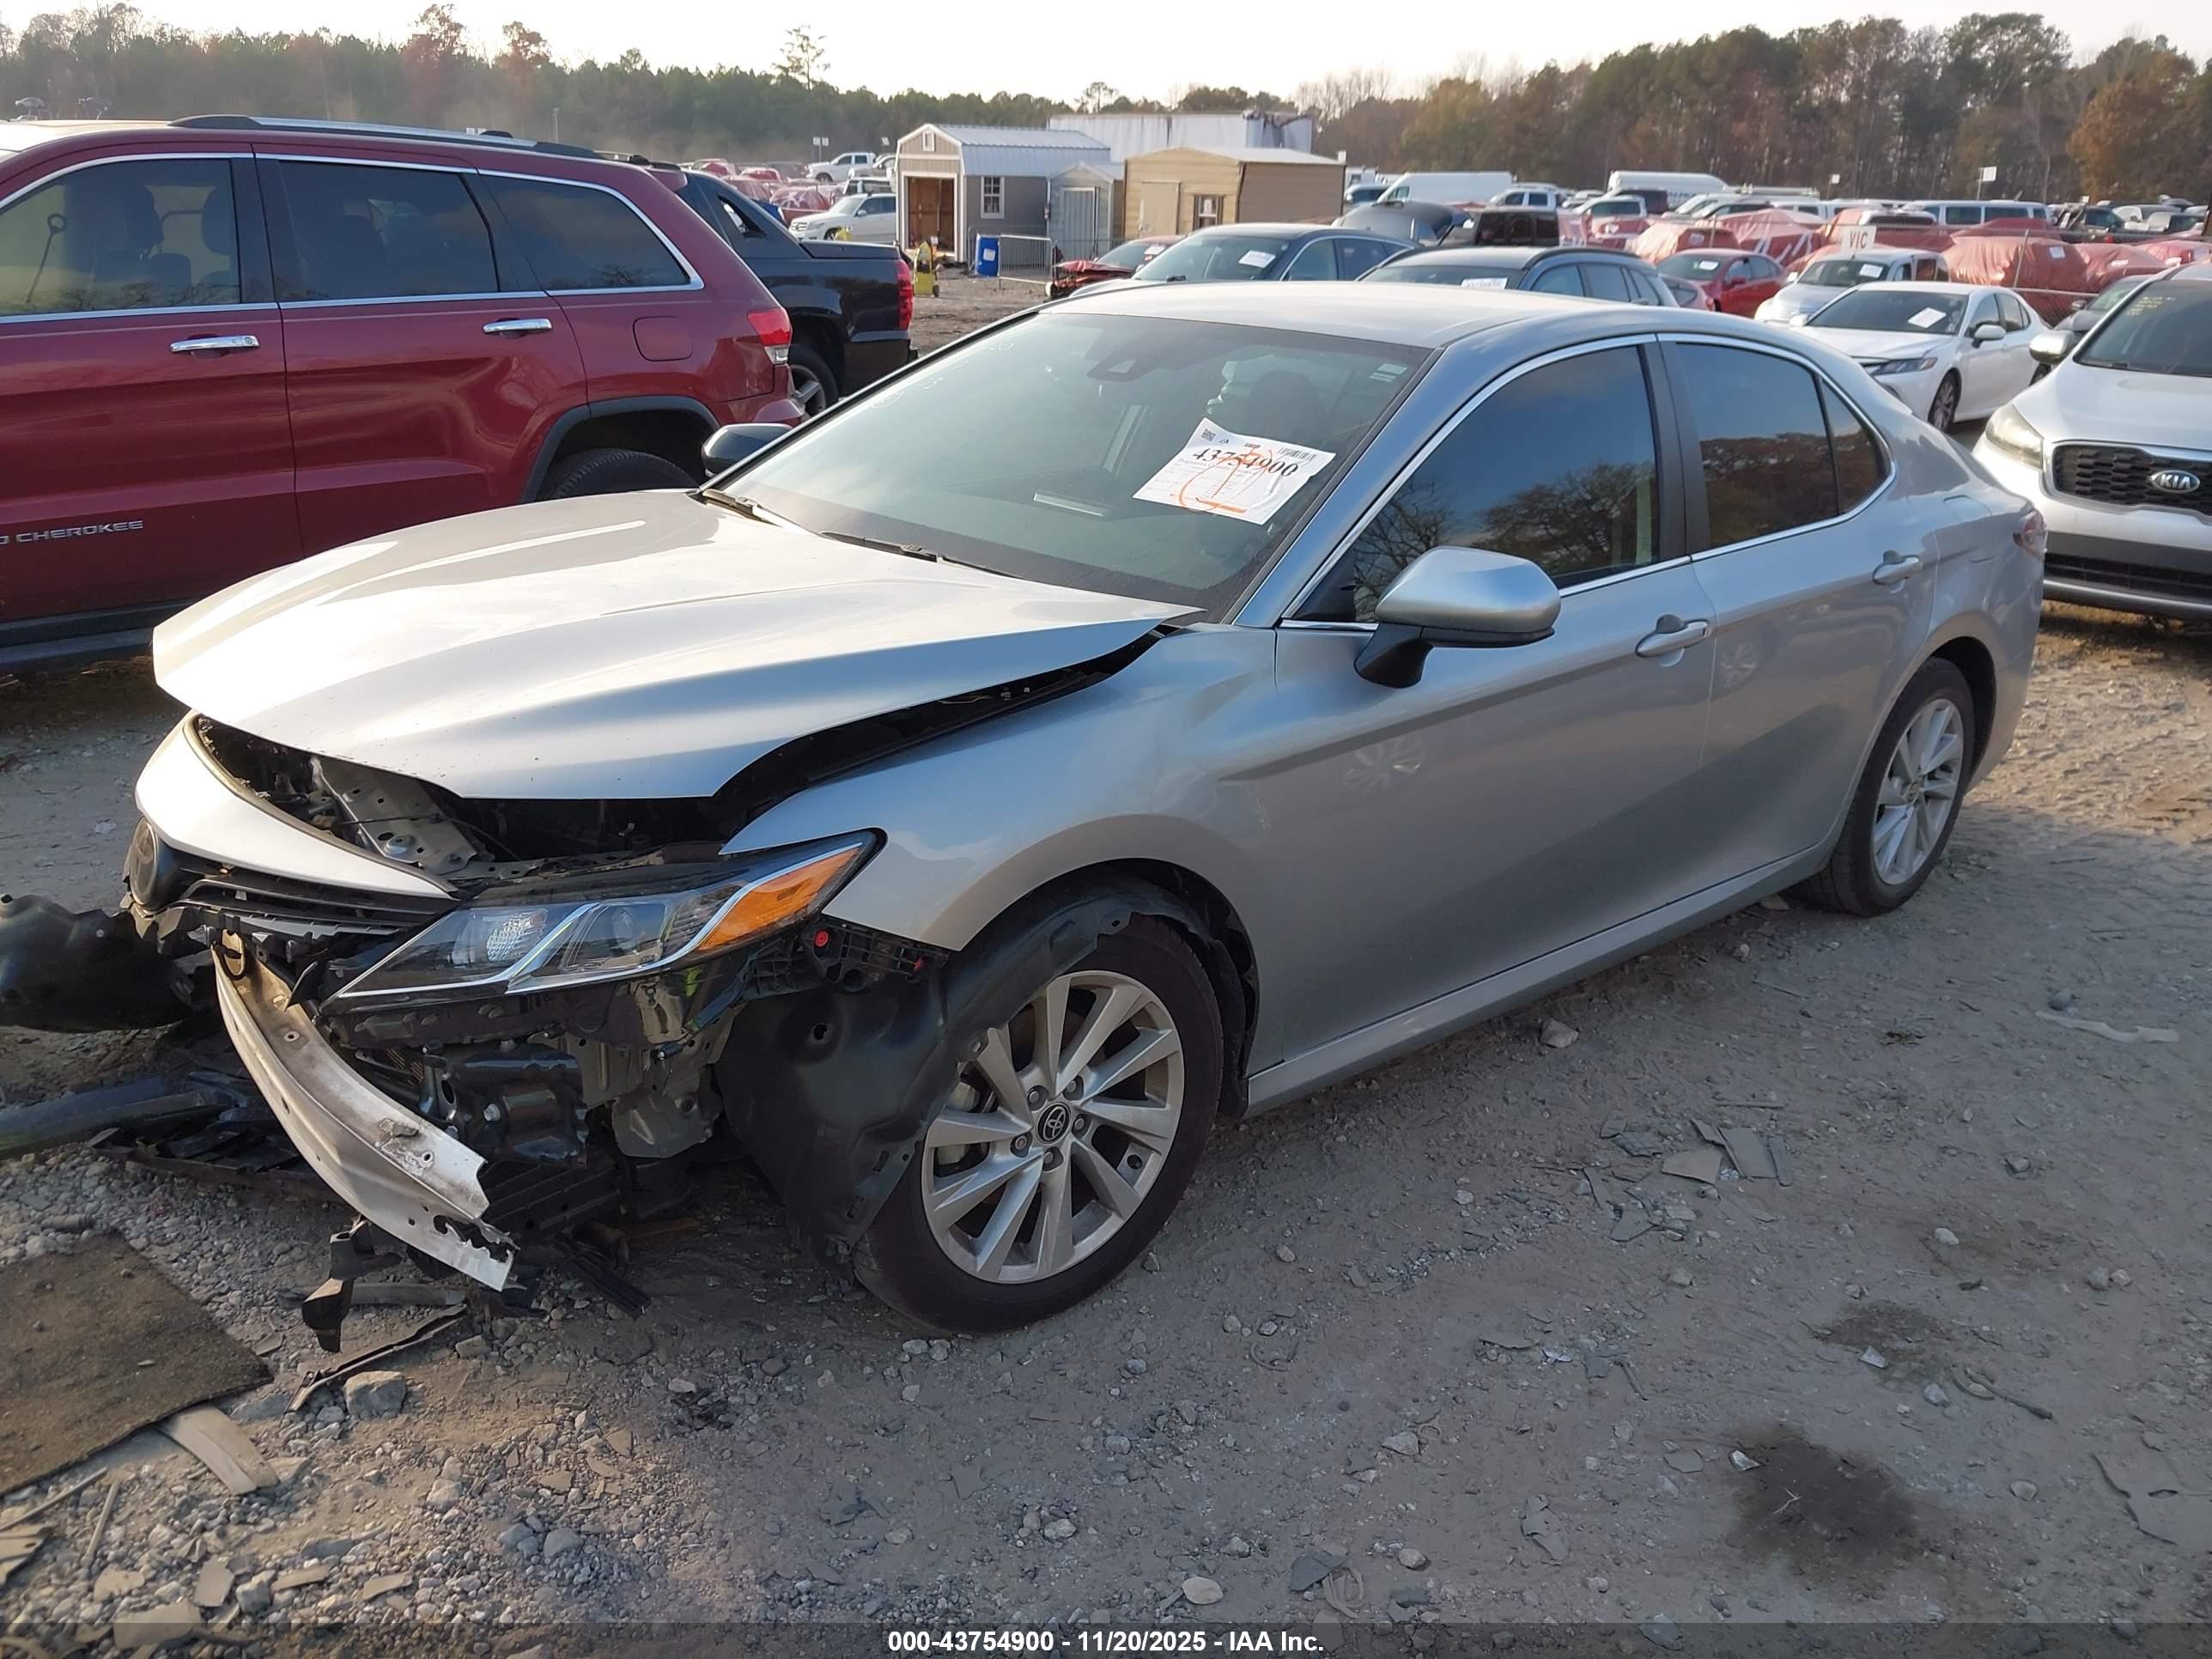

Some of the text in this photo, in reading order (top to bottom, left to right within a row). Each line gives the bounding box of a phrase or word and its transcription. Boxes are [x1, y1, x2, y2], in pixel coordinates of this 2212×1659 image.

[1850, 231, 1869, 249] VIC
[1192, 447, 1299, 477] 43754900
[2160, 473, 2191, 489] KIA
[15, 520, 144, 543] CHEROKEE
